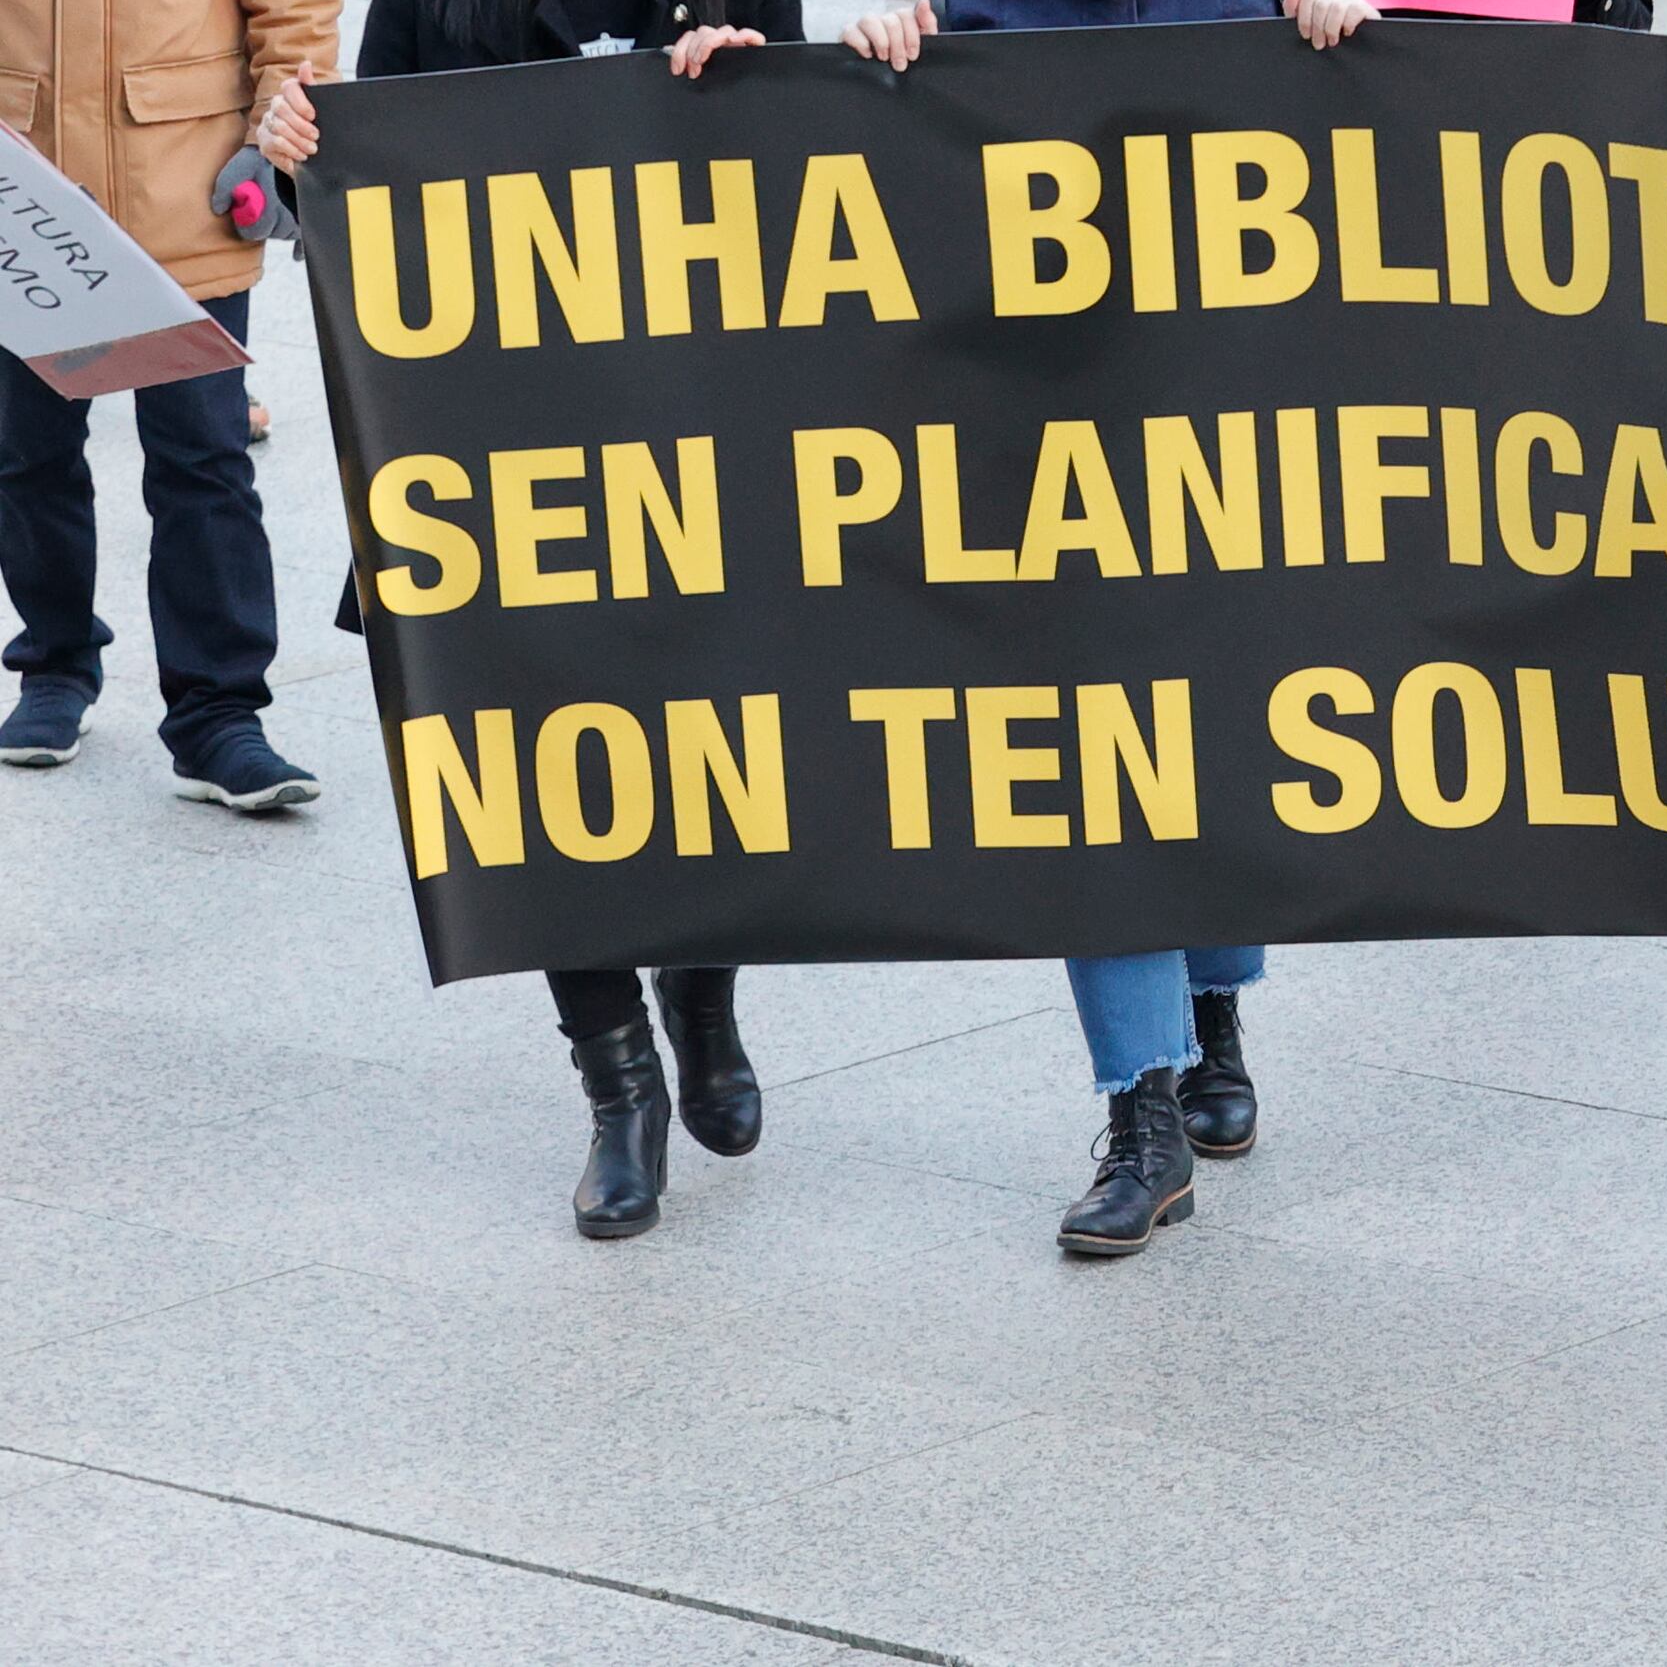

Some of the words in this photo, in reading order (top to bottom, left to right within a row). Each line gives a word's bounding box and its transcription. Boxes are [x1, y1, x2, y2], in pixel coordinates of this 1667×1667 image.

[0, 176, 110, 291] LTURA
[345, 153, 921, 360] UNHA
[368, 435, 725, 617] SEN
[401, 692, 791, 879] NON
[848, 678, 1199, 850] TEN
